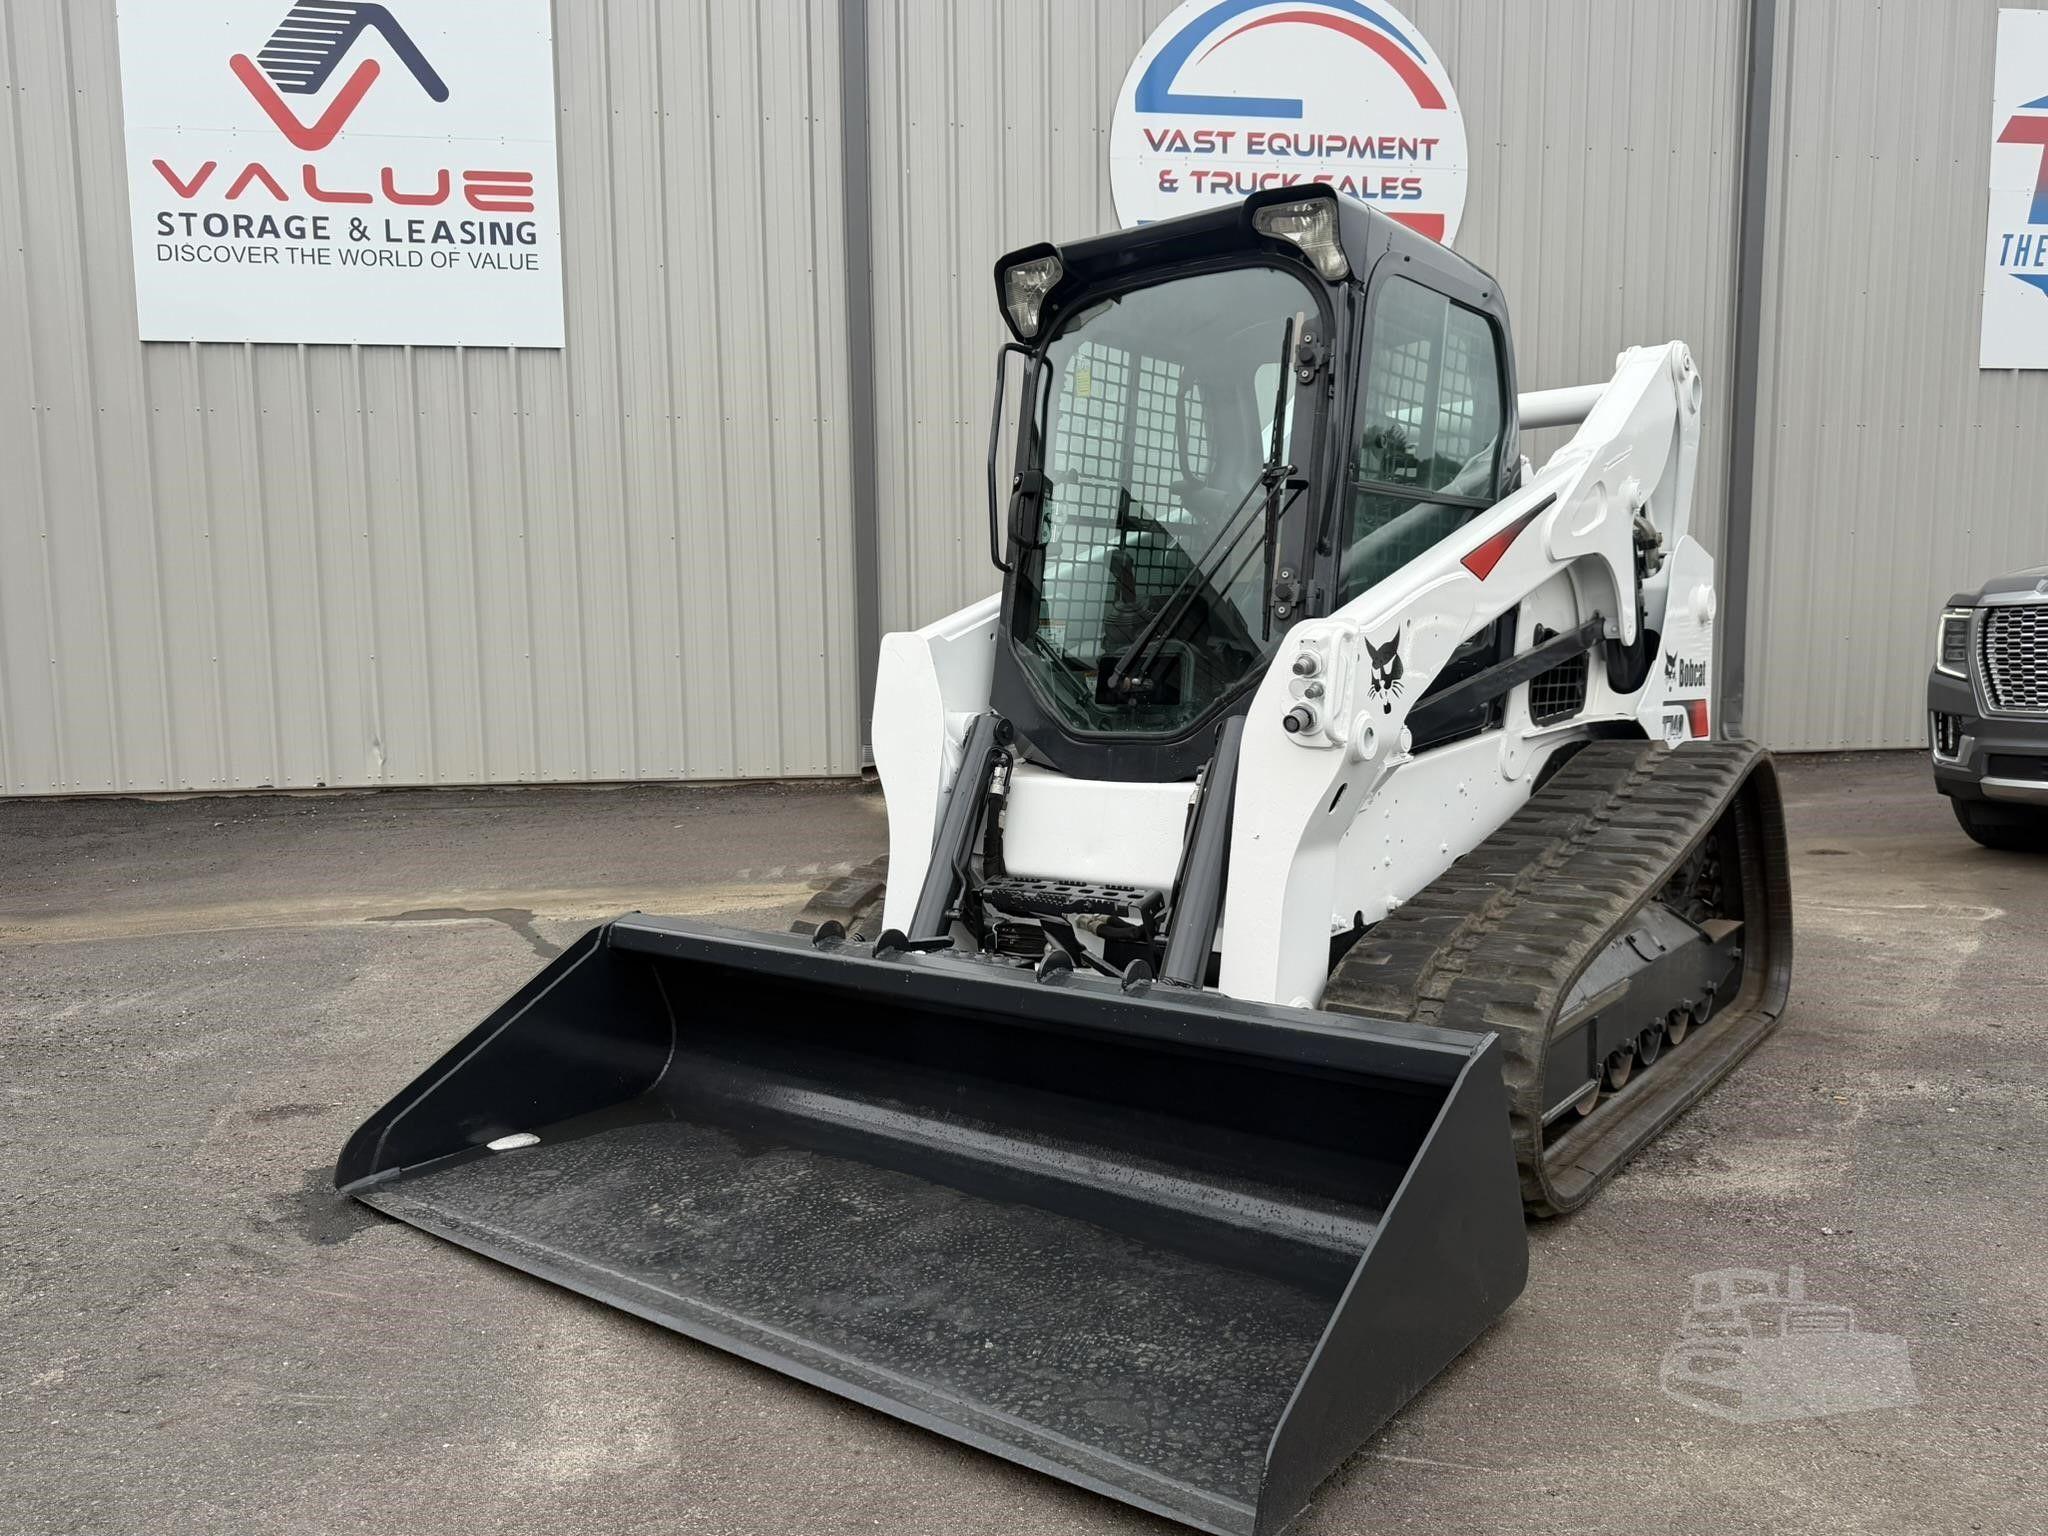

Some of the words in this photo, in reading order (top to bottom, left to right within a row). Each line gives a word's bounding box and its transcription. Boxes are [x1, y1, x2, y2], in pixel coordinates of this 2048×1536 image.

[1143, 128, 1236, 154] VAST
[1246, 132, 1440, 161] EQUIPMENT
[152, 159, 534, 213] VALUE
[1158, 169, 1179, 193] &
[157, 211, 330, 240] STORAGE
[349, 217, 371, 242] &
[384, 218, 537, 246] LEASING
[156, 243, 280, 264] DISCOVER
[285, 246, 331, 266] THE
[338, 248, 424, 268] WORLD
[430, 251, 461, 269] OF
[467, 251, 540, 271] VALUE
[2000, 233, 2048, 267] THE
[1679, 658, 1706, 688] Bobcat
